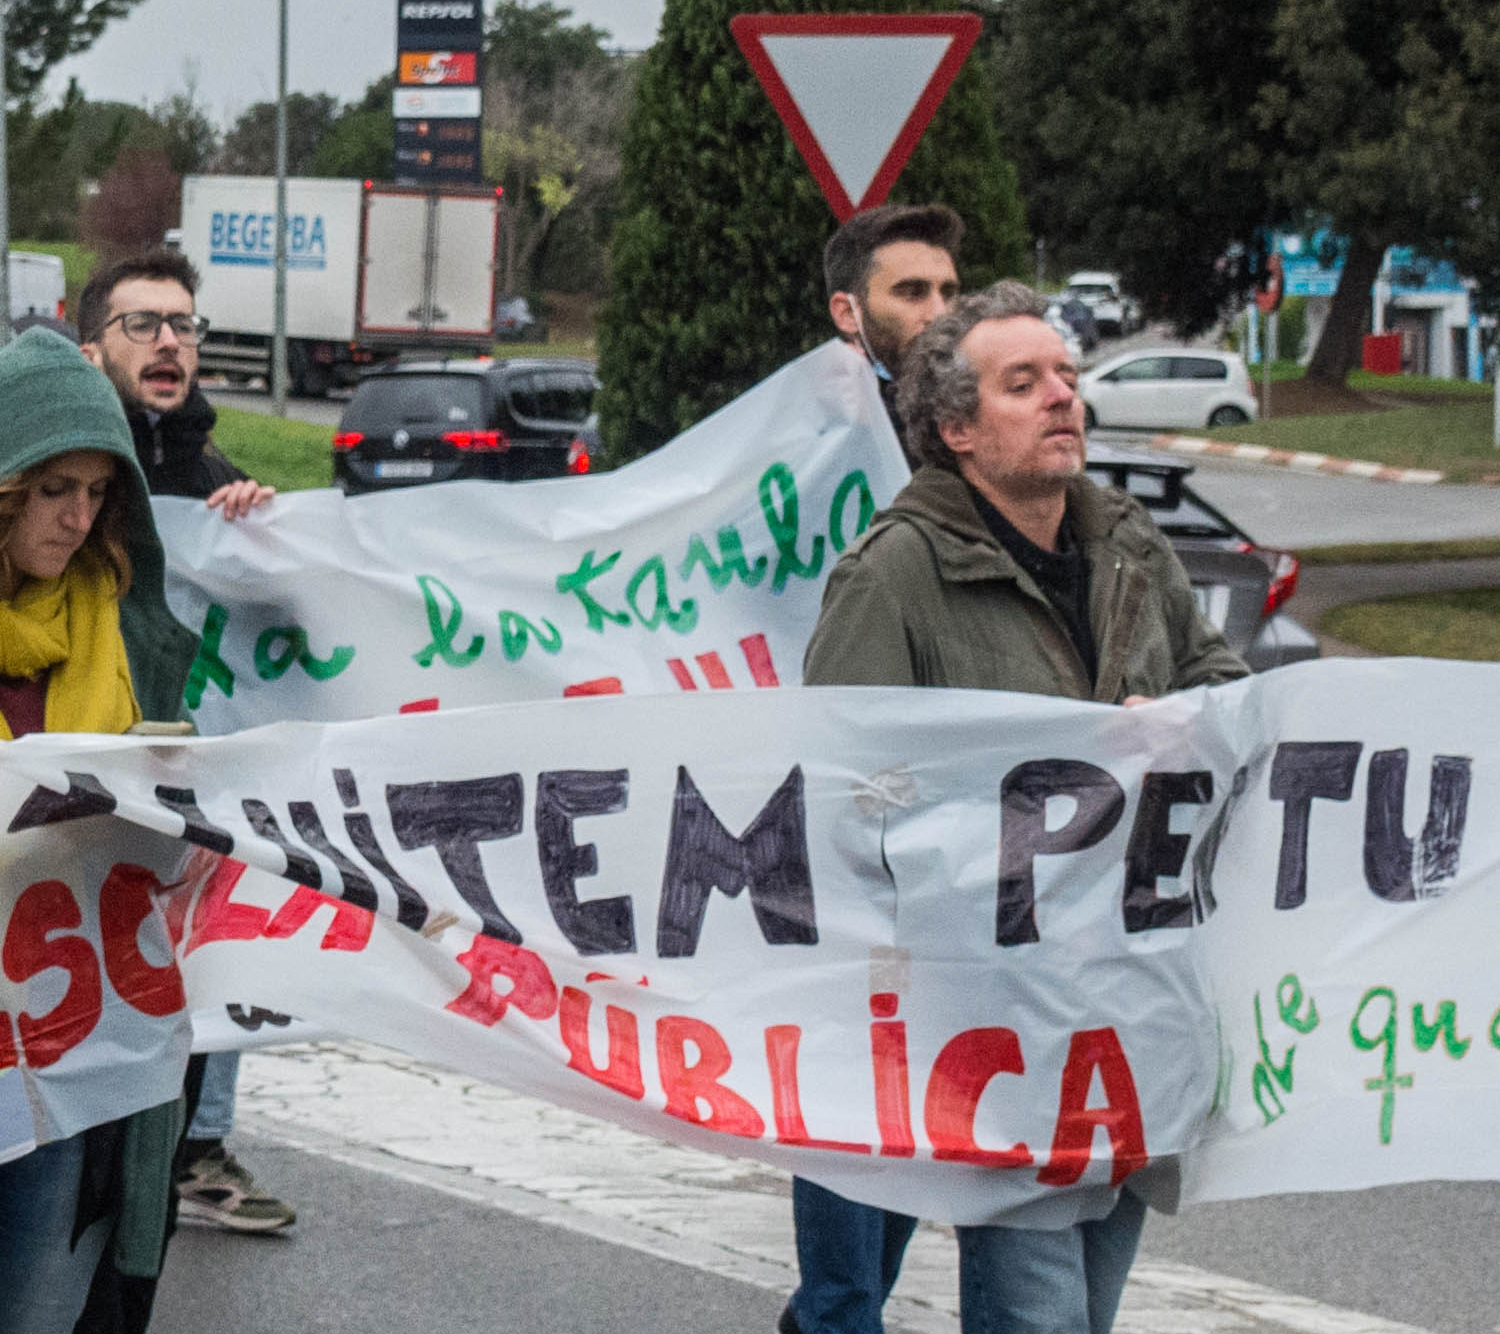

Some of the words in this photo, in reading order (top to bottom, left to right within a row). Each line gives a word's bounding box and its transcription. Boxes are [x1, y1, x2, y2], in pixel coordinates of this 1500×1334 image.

[401, 1, 475, 20] REPSOL
[209, 212, 327, 252] BEGEBA
[1268, 740, 1474, 911] TU
